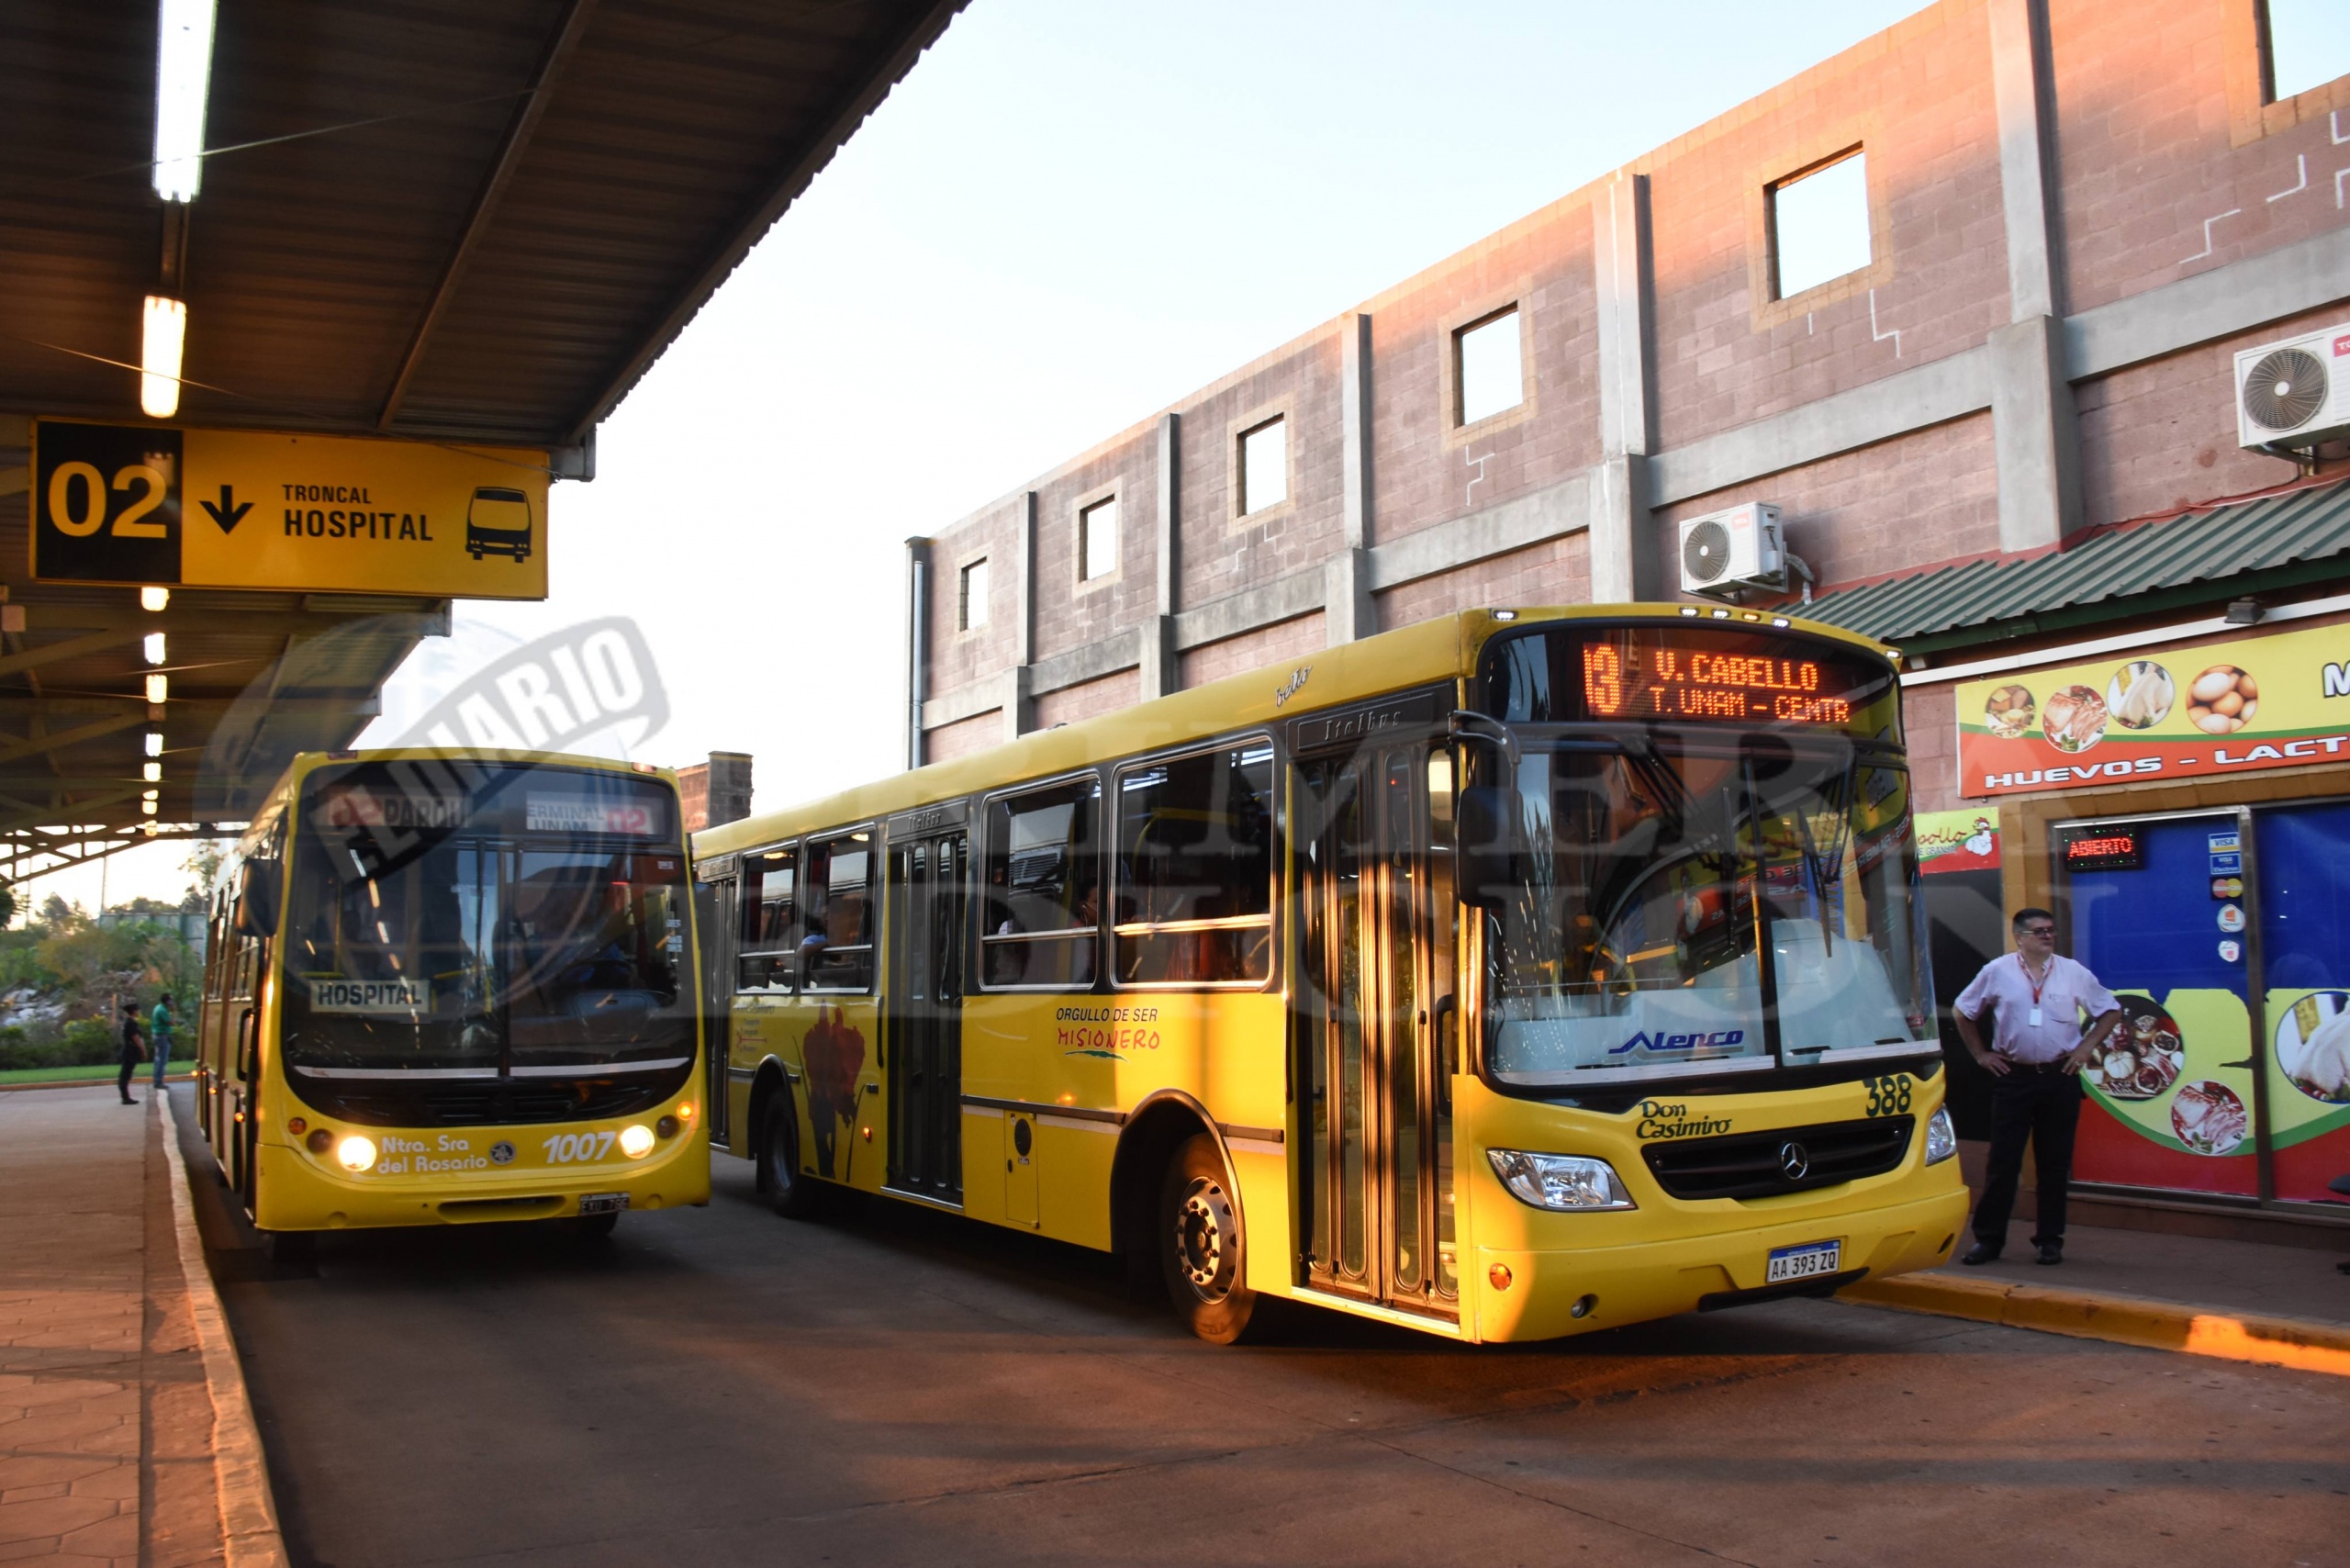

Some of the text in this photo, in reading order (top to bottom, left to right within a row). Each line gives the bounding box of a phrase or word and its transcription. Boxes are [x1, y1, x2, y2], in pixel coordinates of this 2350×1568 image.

[48, 460, 168, 540] 02
[283, 484, 373, 504] TRONCAL
[284, 509, 433, 542] HOSPITAL
[1691, 654, 1818, 690] CABELLO
[1984, 756, 2162, 790] HUEVOS
[607, 808, 647, 834] 02
[2069, 837, 2132, 859] ABIERTO
[318, 984, 422, 1007] HOSPITAL
[1056, 1007, 1158, 1022] ORGULLO DE SER
[1058, 1026, 1160, 1050] MISIONERO
[1862, 1074, 1912, 1118] 388
[1638, 1100, 1686, 1118] Don
[1636, 1115, 1733, 1139] Casimiro
[438, 1135, 469, 1152] Sra
[542, 1132, 616, 1163] 1007
[377, 1155, 488, 1174] del Rosario
[1772, 1260, 1787, 1279] AA
[1792, 1254, 1817, 1275] 393
